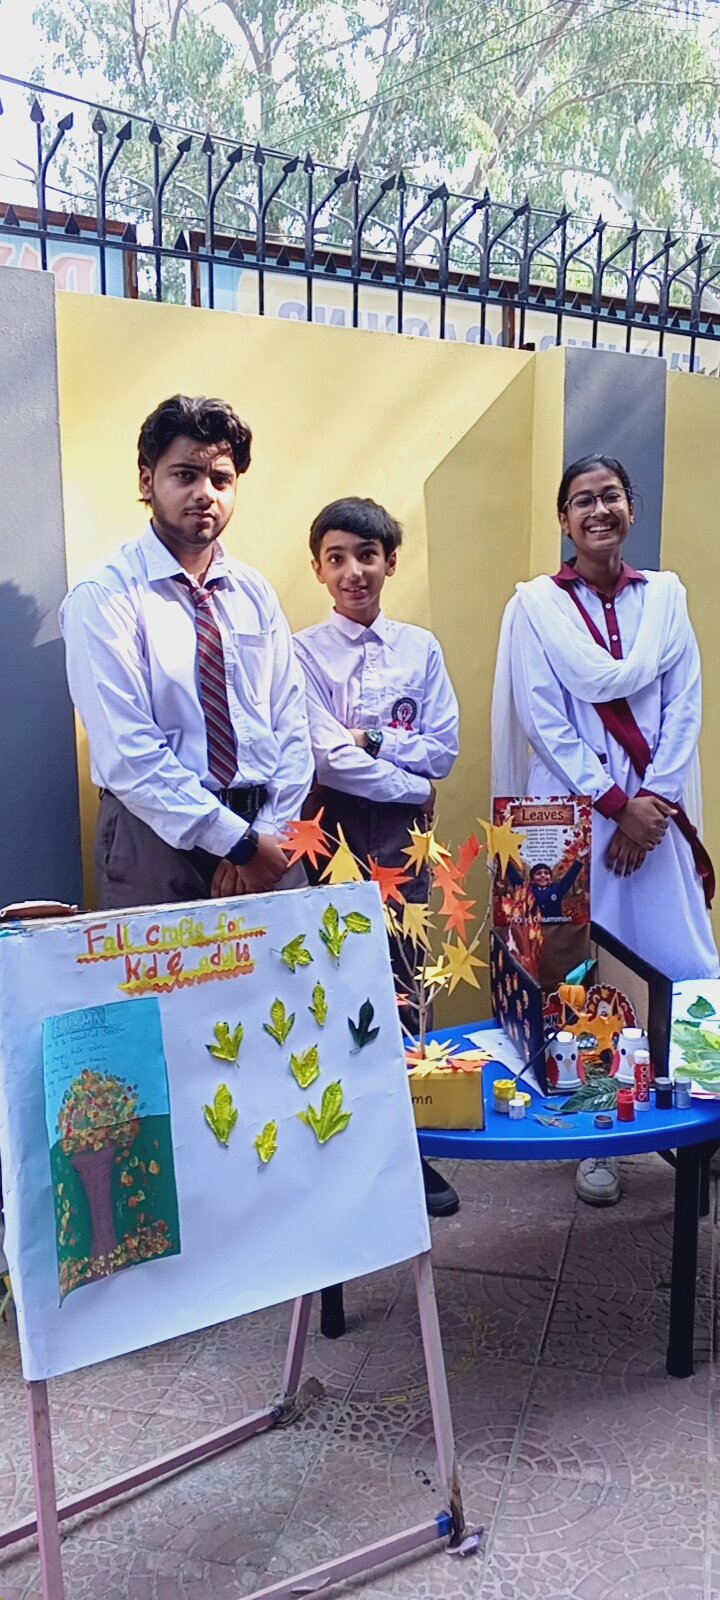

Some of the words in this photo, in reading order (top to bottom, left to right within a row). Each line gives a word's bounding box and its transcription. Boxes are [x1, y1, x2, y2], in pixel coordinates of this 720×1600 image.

[522, 808, 565, 821] Leaves
[533, 915, 572, 924] Cumman
[84, 923, 133, 955] Fall
[214, 912, 246, 935] for
